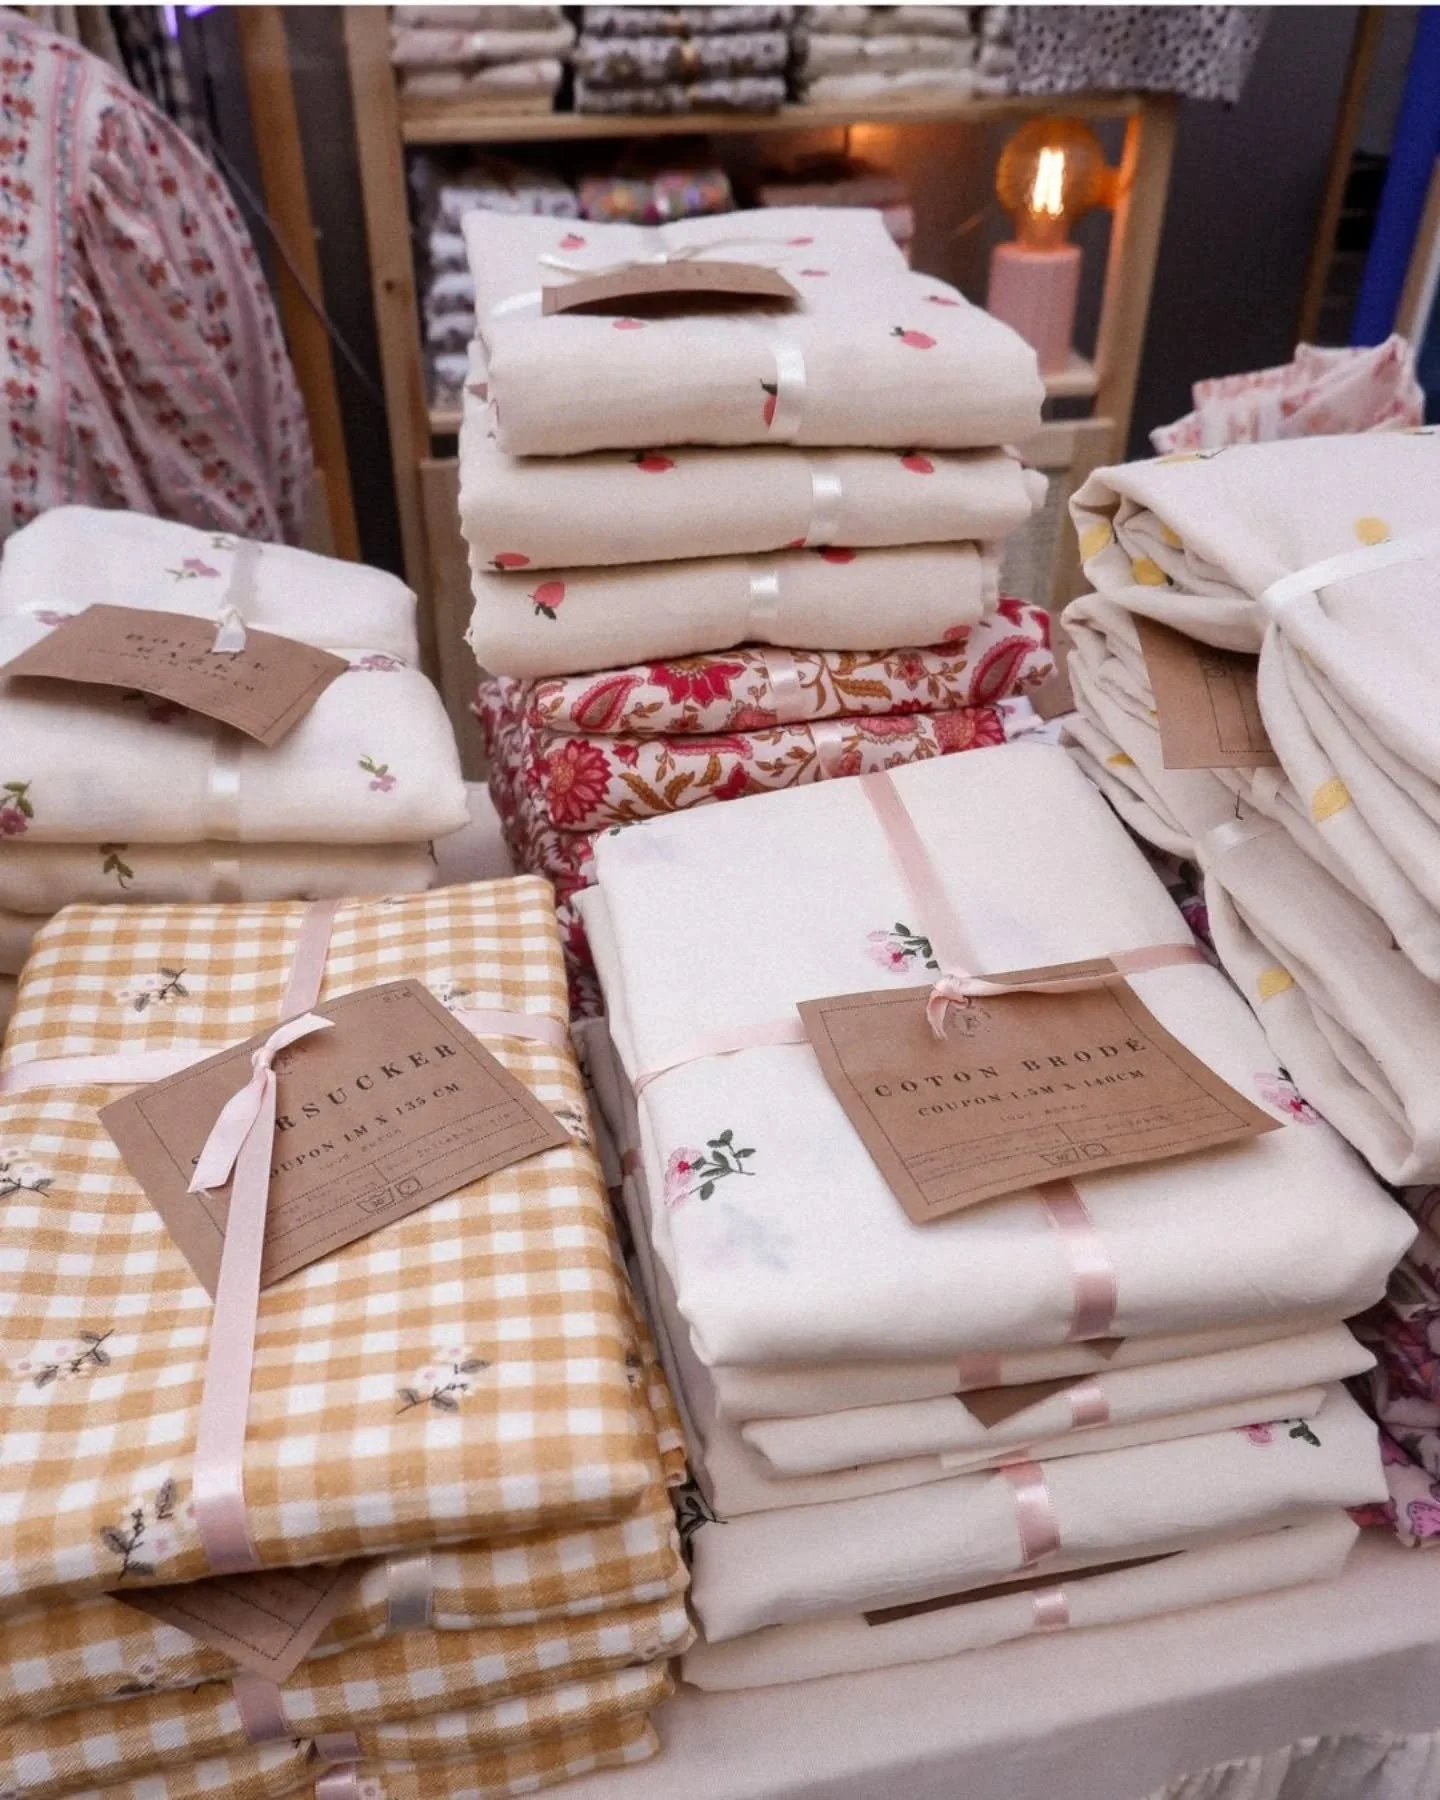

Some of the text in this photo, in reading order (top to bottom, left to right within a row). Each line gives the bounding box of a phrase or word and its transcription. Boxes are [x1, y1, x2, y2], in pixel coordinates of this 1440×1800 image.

[874, 1066, 999, 1097] COTON
[918, 1093, 1002, 1116] COUPON
[1062, 1082, 1077, 1091] X
[269, 1140, 334, 1178] OUPON
[343, 1124, 369, 1142] 1M
[375, 1114, 388, 1126] X
[395, 1096, 427, 1116] 135
[432, 1083, 460, 1099] CM
